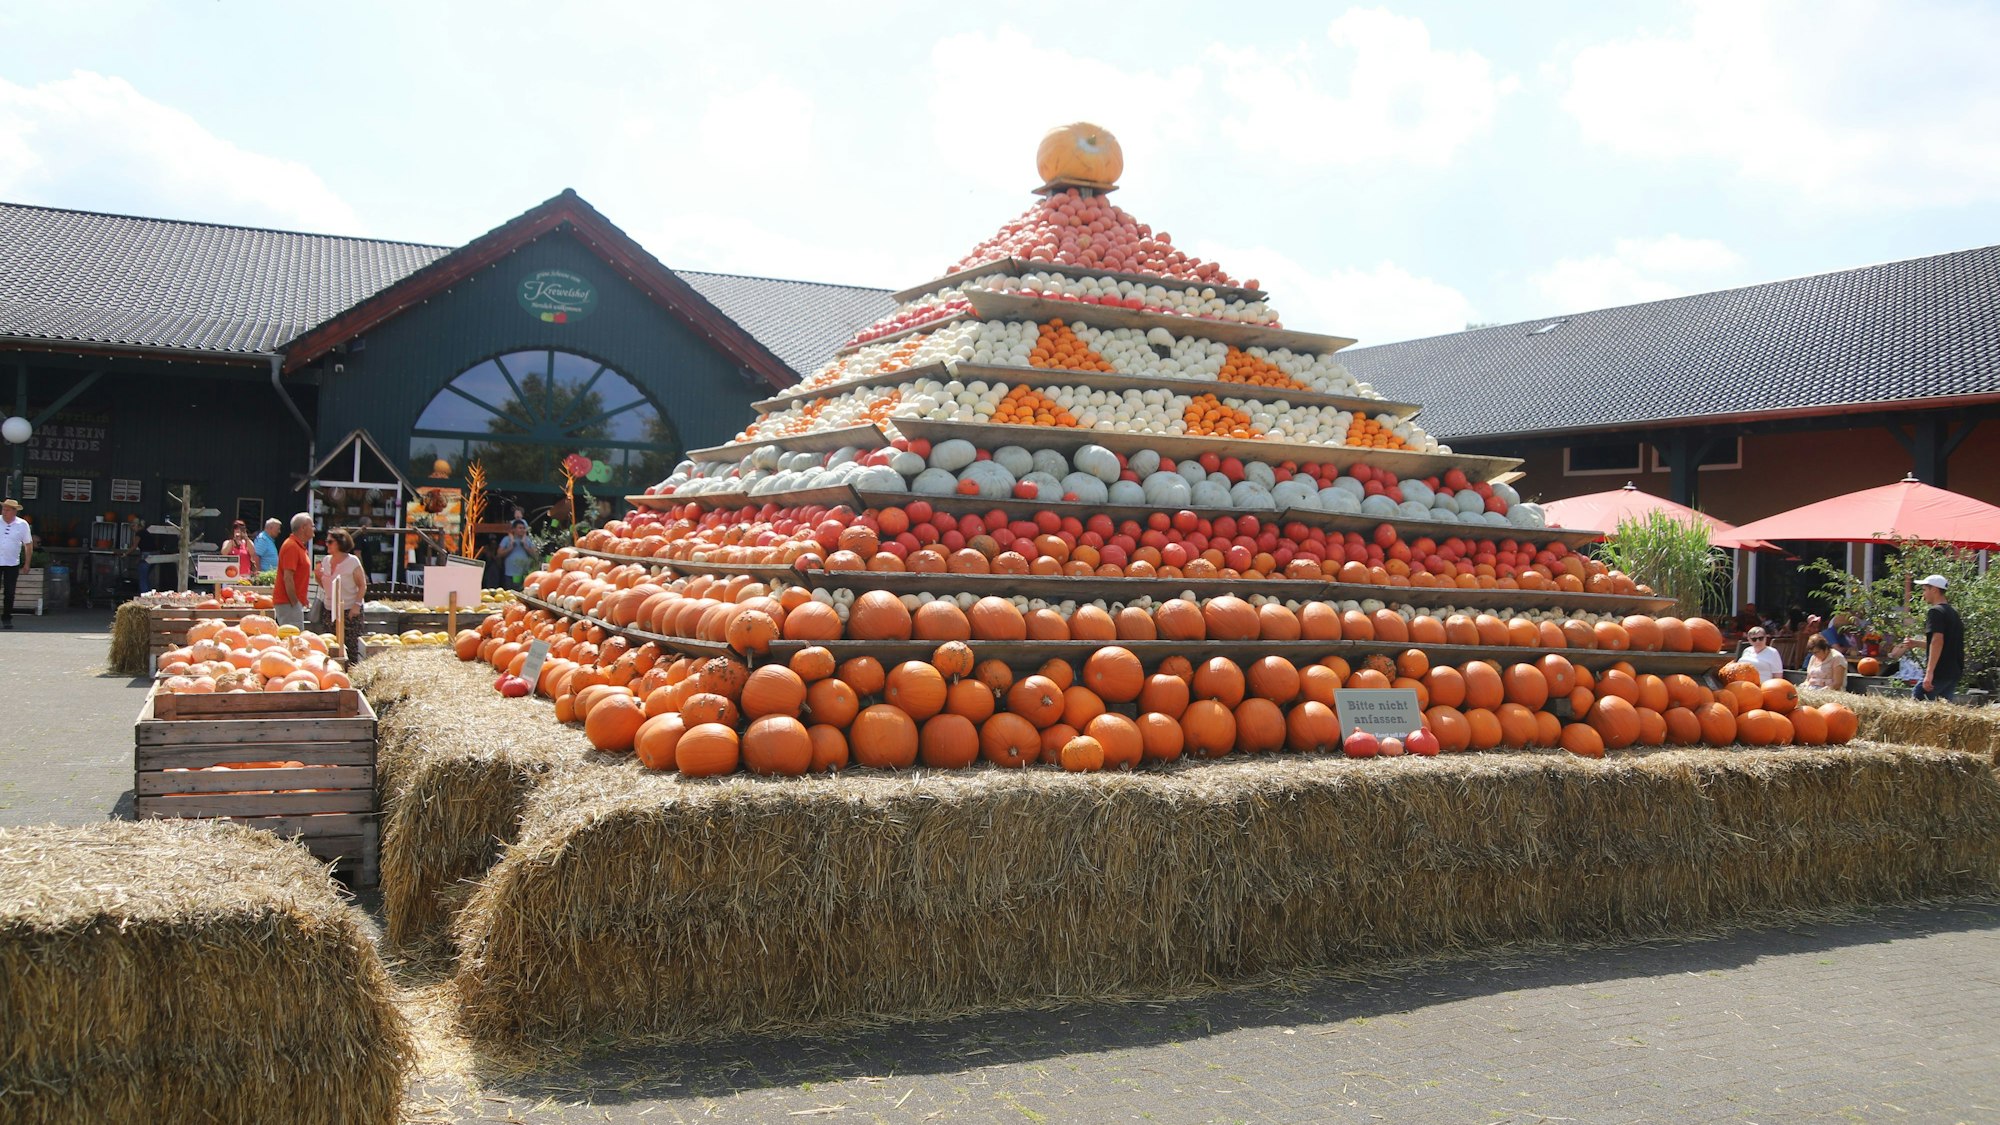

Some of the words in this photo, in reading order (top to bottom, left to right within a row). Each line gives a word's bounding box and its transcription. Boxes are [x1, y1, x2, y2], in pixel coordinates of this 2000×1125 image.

[523, 280, 591, 305] Krewelshof
[63, 426, 106, 440] REIN
[45, 437, 100, 451] FINDE
[28, 448, 74, 462] RAUS!
[1347, 700, 1375, 711] Bitte
[1378, 700, 1408, 711] nicht
[1354, 714, 1408, 724] anfassen.
